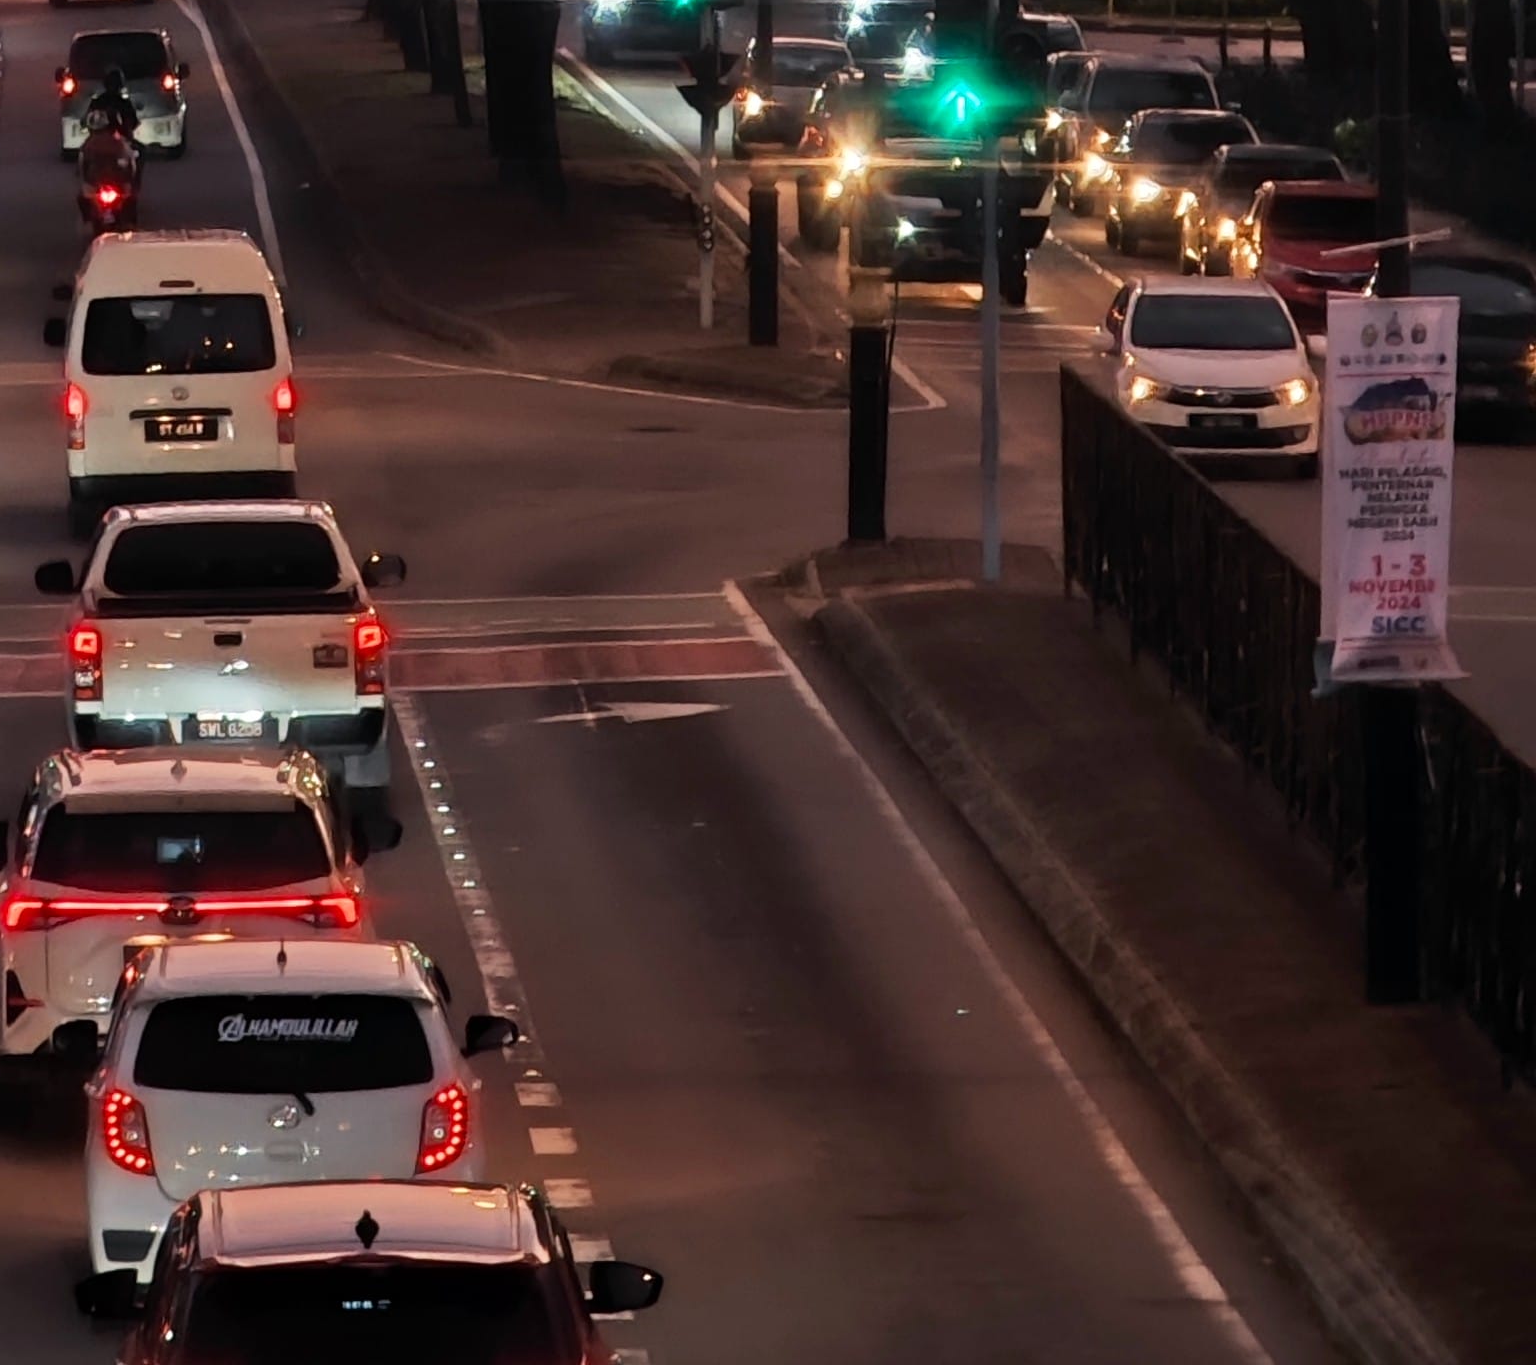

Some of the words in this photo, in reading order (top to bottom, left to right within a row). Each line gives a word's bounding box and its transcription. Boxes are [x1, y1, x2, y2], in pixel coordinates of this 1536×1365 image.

[1339, 467, 1374, 479] HARI
[1371, 554, 1382, 576] 1
[1409, 554, 1427, 577] 3
[1376, 596, 1421, 610] 2024
[1371, 615, 1427, 634] SICC
[198, 722, 226, 737] SWL
